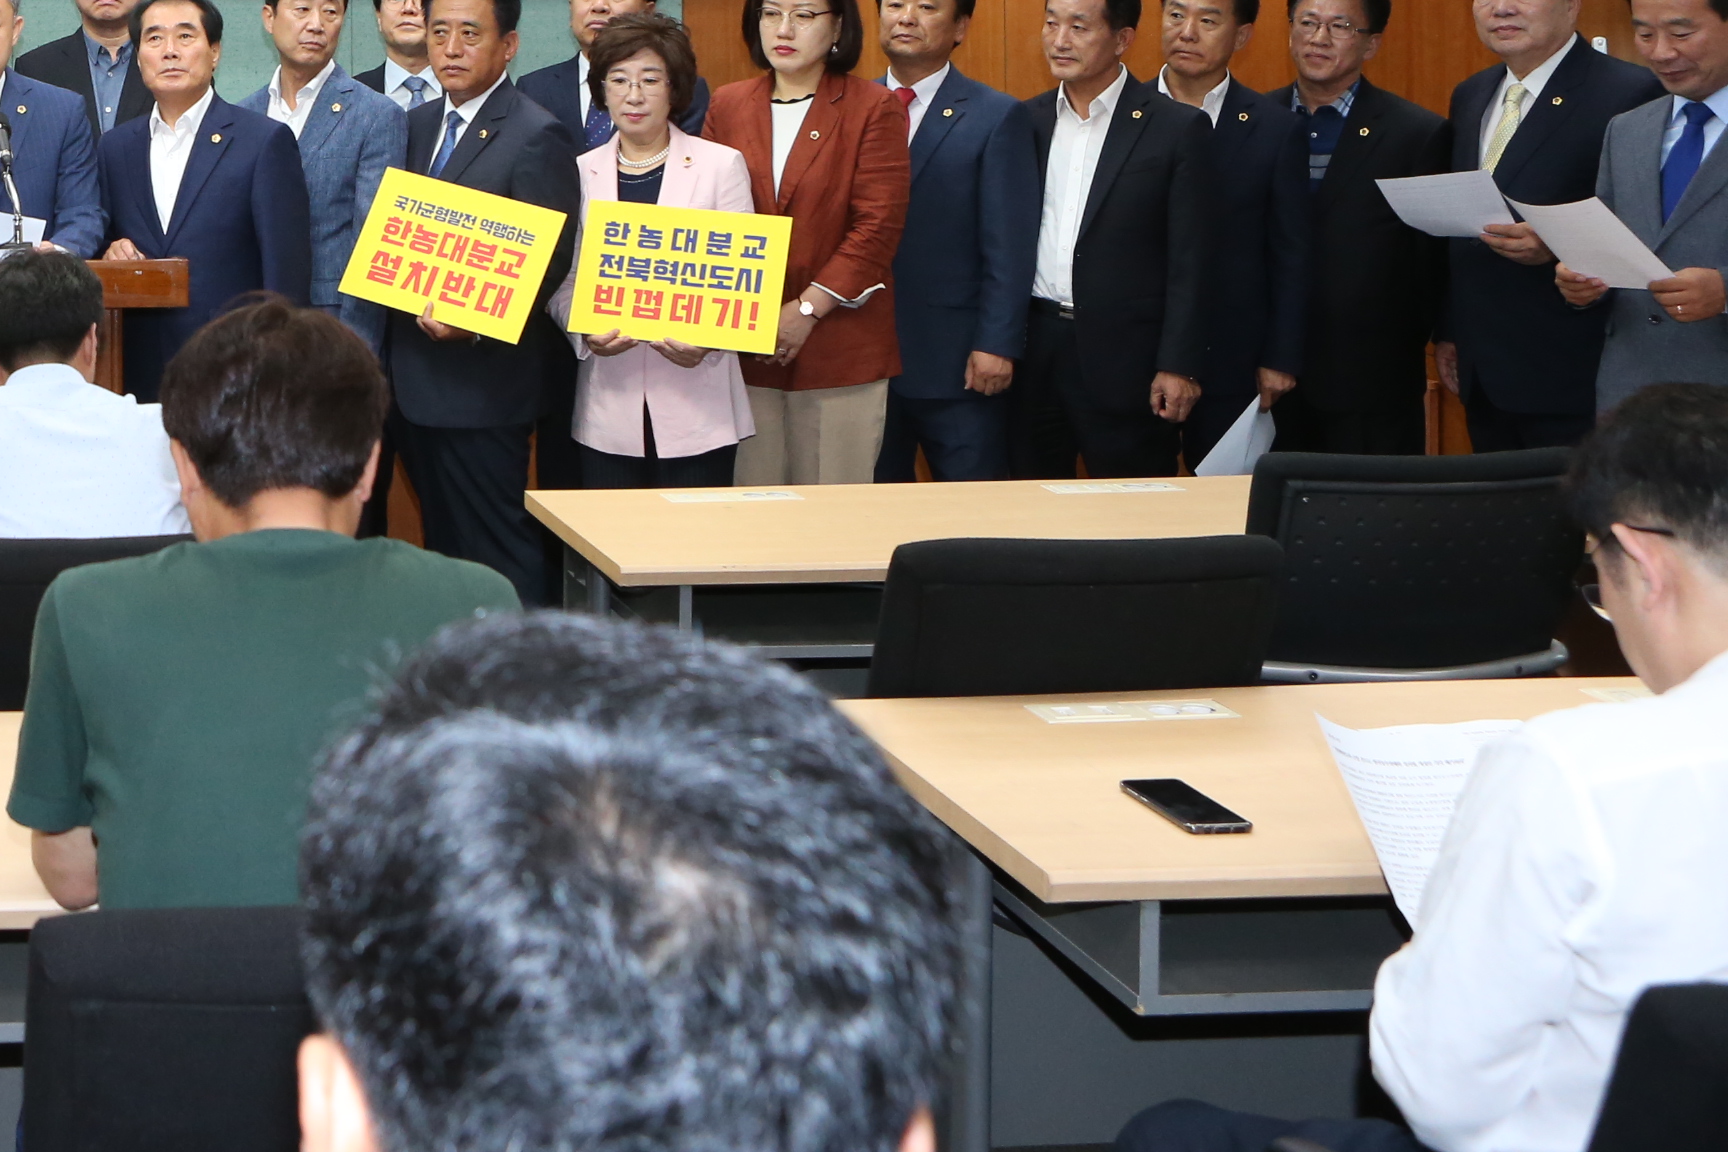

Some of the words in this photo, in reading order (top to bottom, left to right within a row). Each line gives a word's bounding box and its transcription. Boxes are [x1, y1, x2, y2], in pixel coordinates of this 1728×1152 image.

[394, 195, 477, 230] 국가균형발전
[479, 219, 536, 246] 역행하는
[380, 216, 528, 279] 한농대분교
[366, 250, 515, 319] 설치반대
[598, 253, 764, 294] 전북혁신도시
[593, 284, 760, 331] 빈껍데기!
